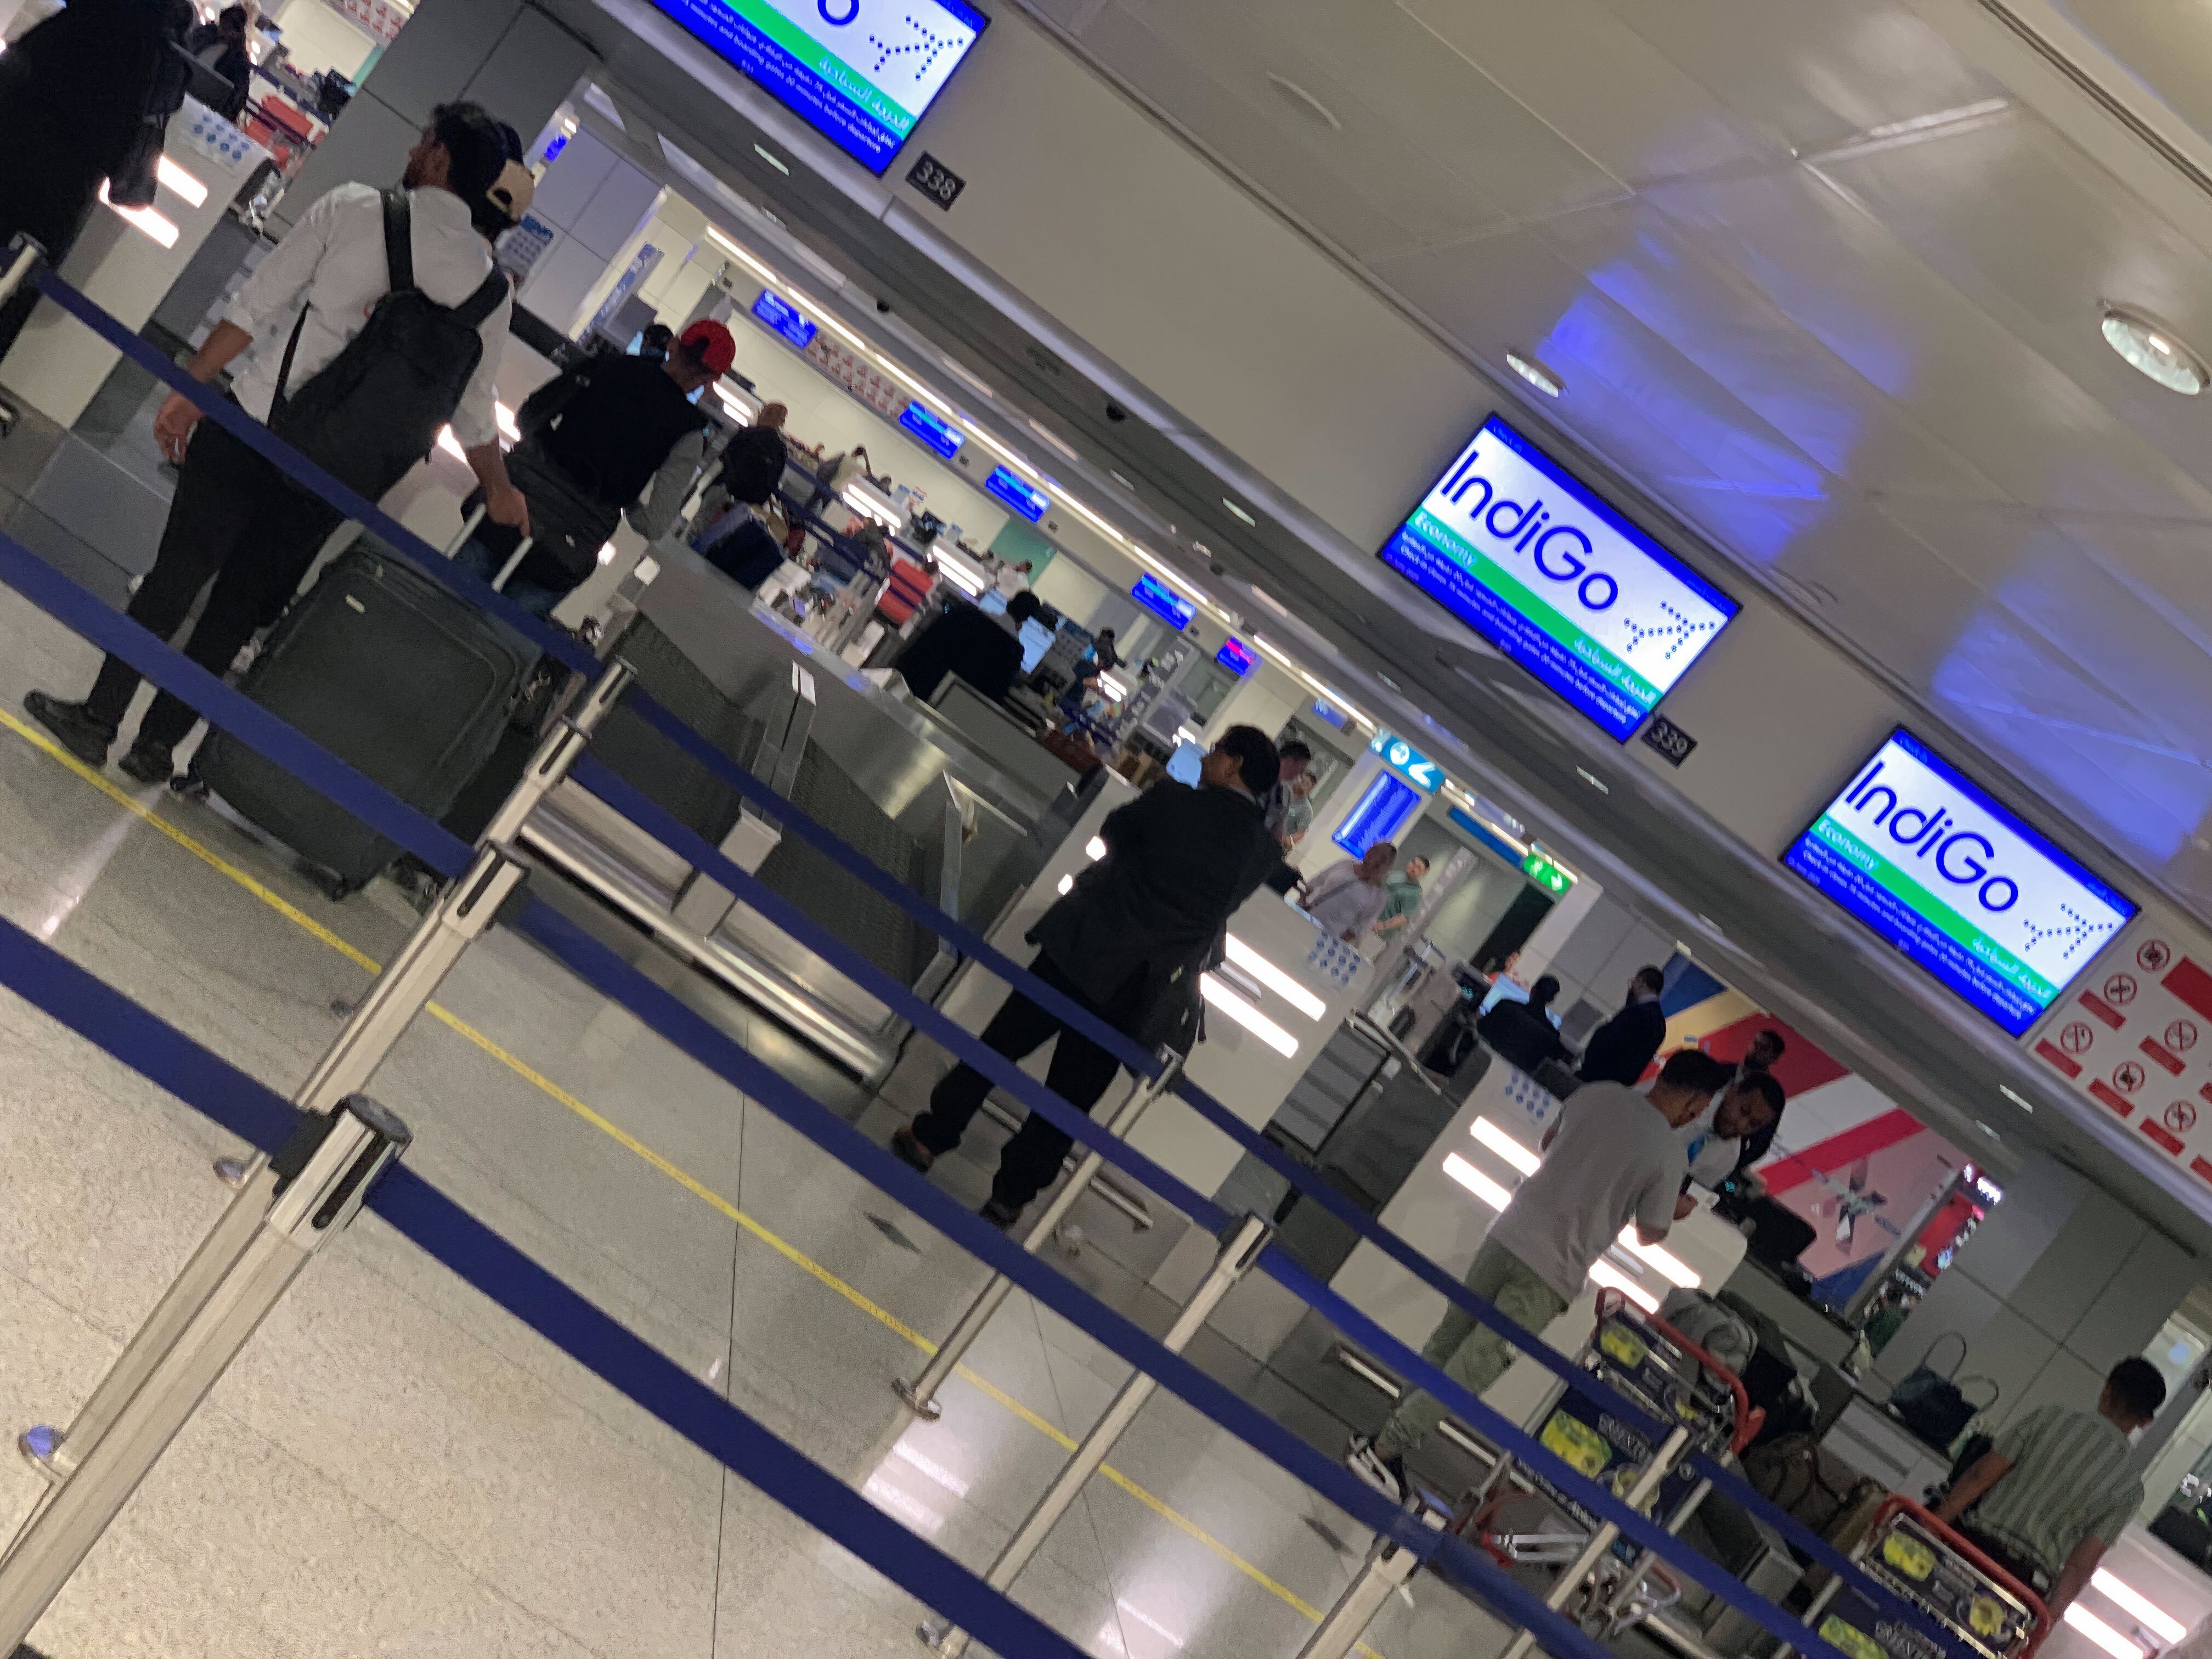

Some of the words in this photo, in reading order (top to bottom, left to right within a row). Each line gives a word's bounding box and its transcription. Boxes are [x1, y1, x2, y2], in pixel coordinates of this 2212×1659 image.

[917, 161, 956, 199] 338
[1441, 451, 1618, 611] IndiGo
[1846, 760, 2018, 912] IndiGo
